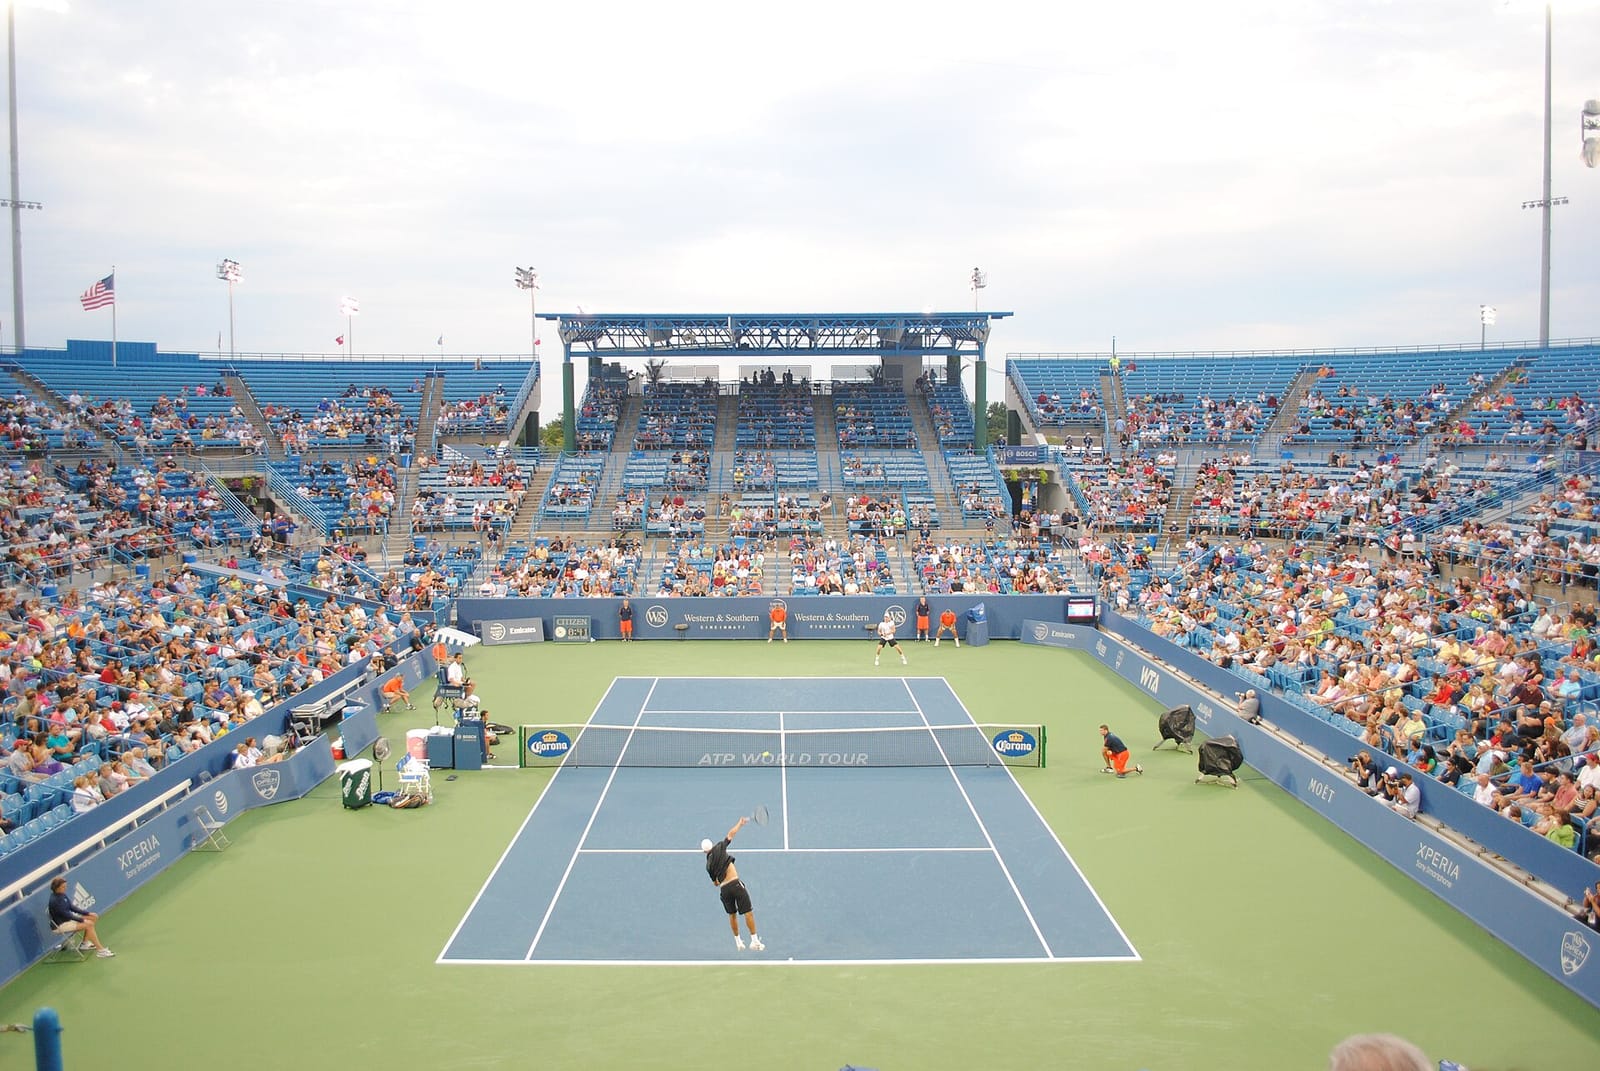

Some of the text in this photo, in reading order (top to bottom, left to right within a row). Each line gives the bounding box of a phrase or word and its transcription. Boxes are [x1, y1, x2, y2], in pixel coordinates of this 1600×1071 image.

[556, 618, 587, 626] CITIZEN
[684, 613, 760, 622] Western & Southern
[794, 613, 870, 621] Western & Southern
[1051, 629, 1076, 639] Emirates
[1140, 665, 1160, 694] WTA
[531, 740, 568, 754] Corona
[995, 740, 1032, 752] Corona
[697, 752, 869, 765] ATP WORLD TOUR
[117, 834, 160, 871] XPERIA
[1416, 842, 1459, 880] XPERIA
